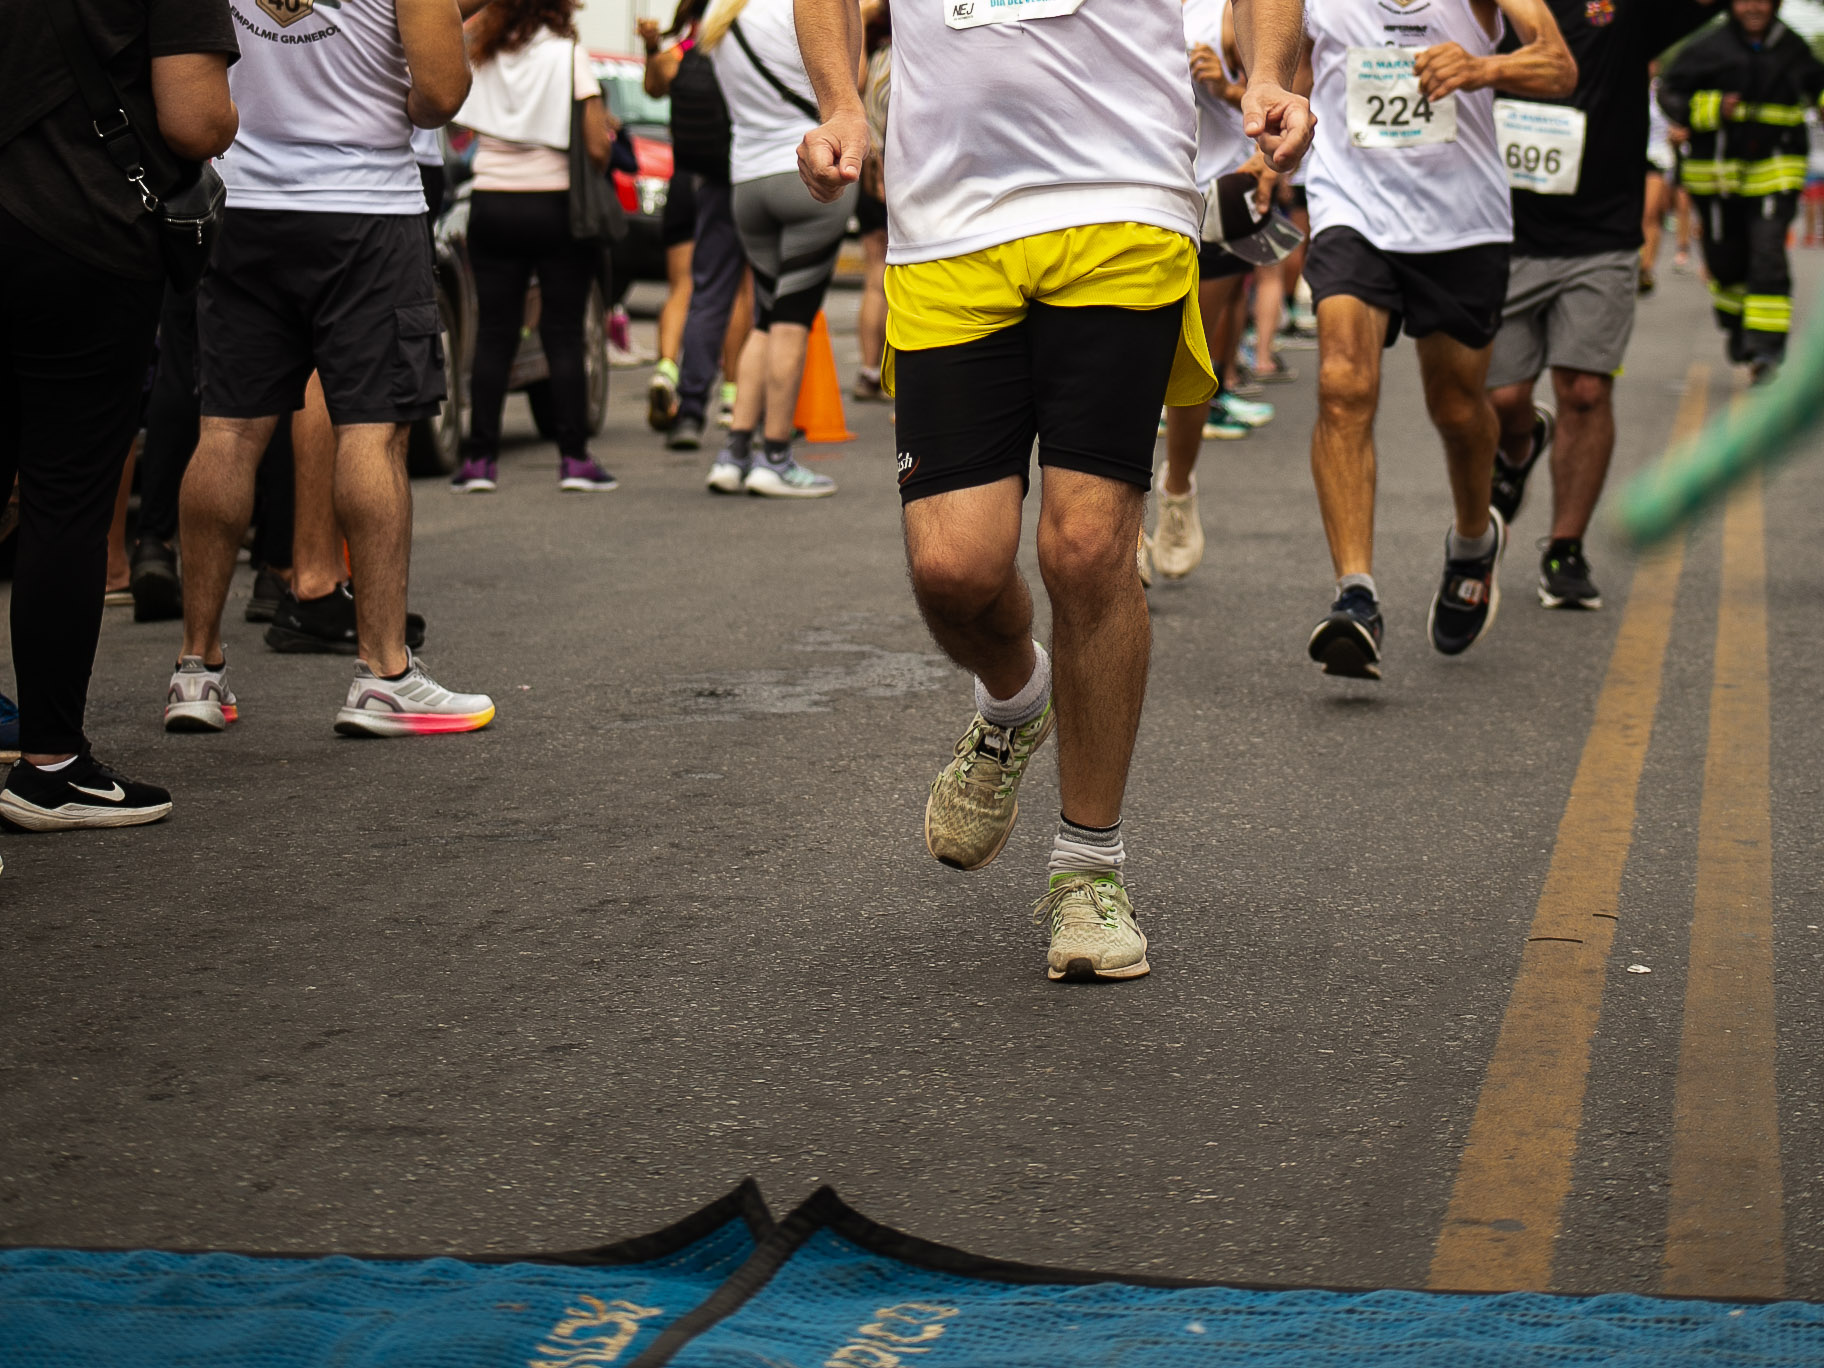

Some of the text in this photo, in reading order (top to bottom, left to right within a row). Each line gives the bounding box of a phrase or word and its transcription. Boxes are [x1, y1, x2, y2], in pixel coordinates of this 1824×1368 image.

[231, 5, 279, 42] EMPALME
[1366, 95, 1434, 126] 224
[1506, 142, 1561, 174] 696
